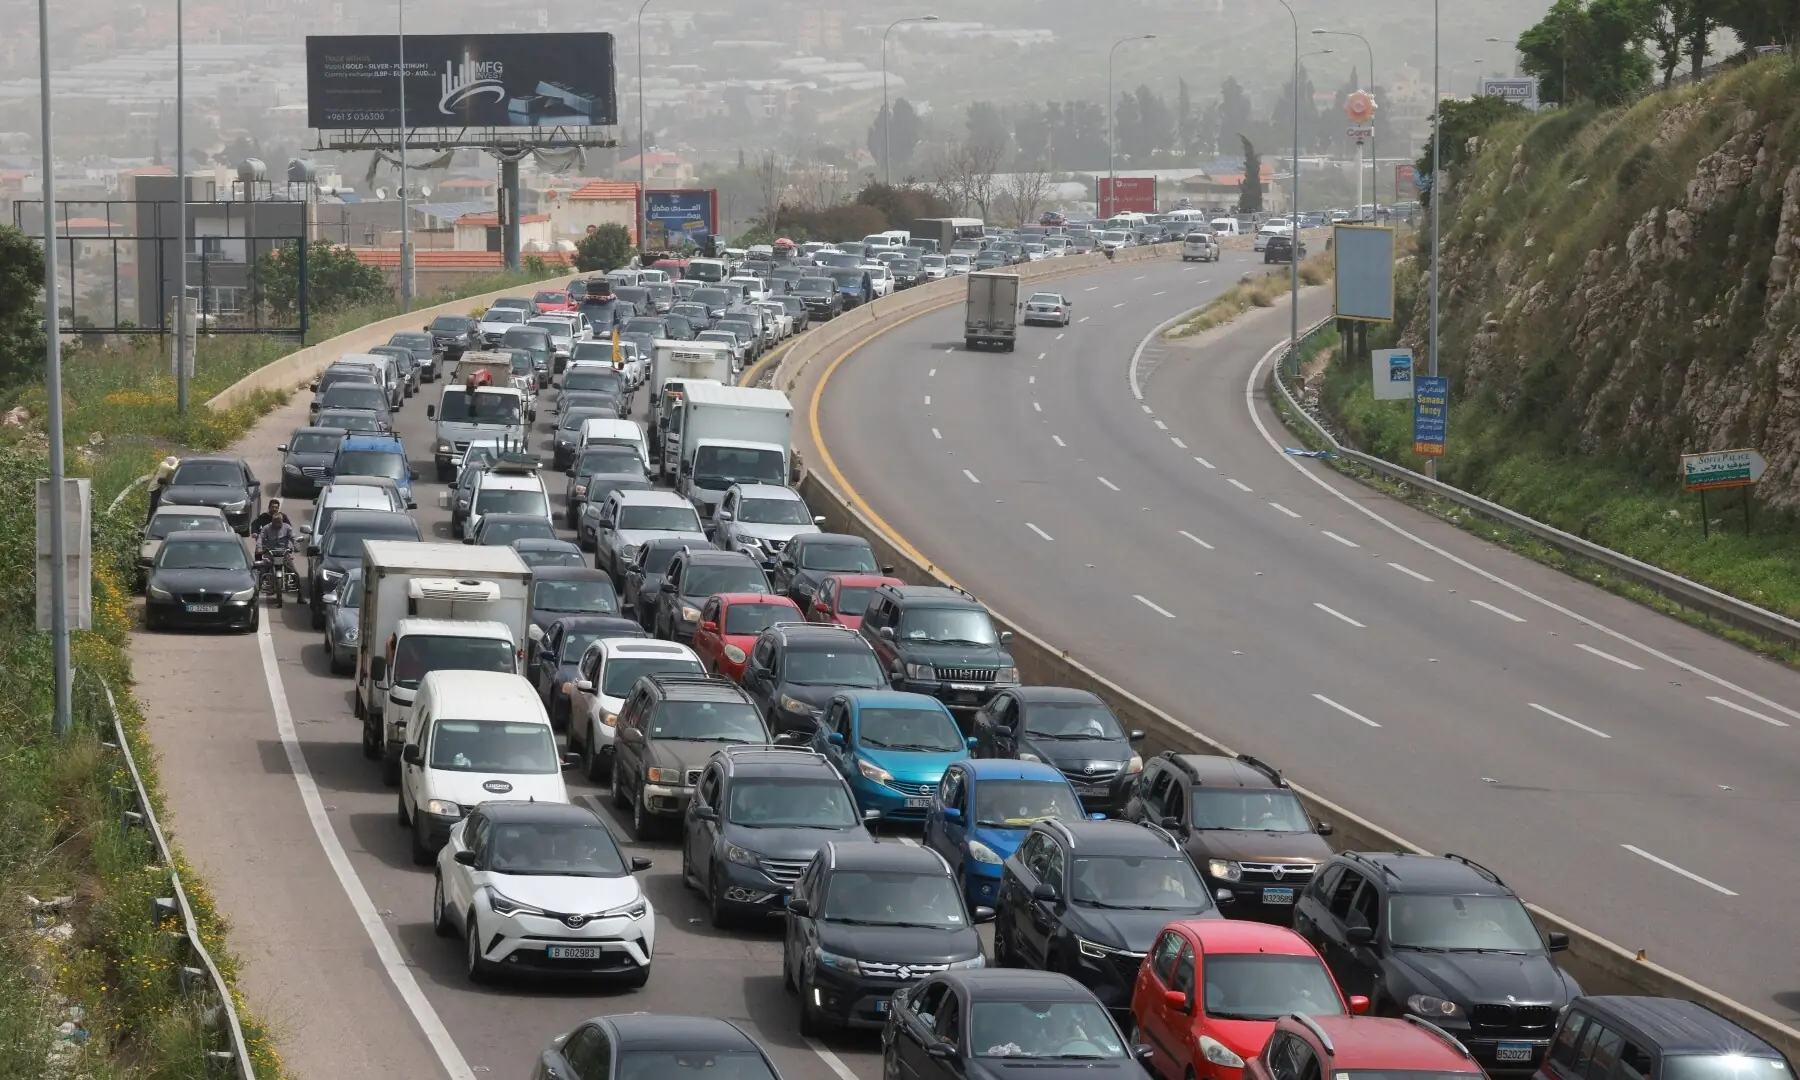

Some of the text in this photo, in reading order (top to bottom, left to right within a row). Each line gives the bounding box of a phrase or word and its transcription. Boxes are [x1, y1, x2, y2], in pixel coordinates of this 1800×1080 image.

[475, 61, 503, 72] MFG
[1488, 85, 1528, 96] Optimal
[1417, 394, 1445, 405] Samana
[1420, 405, 1441, 417] Honey
[564, 948, 595, 958] 602983
[1497, 1049, 1532, 1060] B520271
